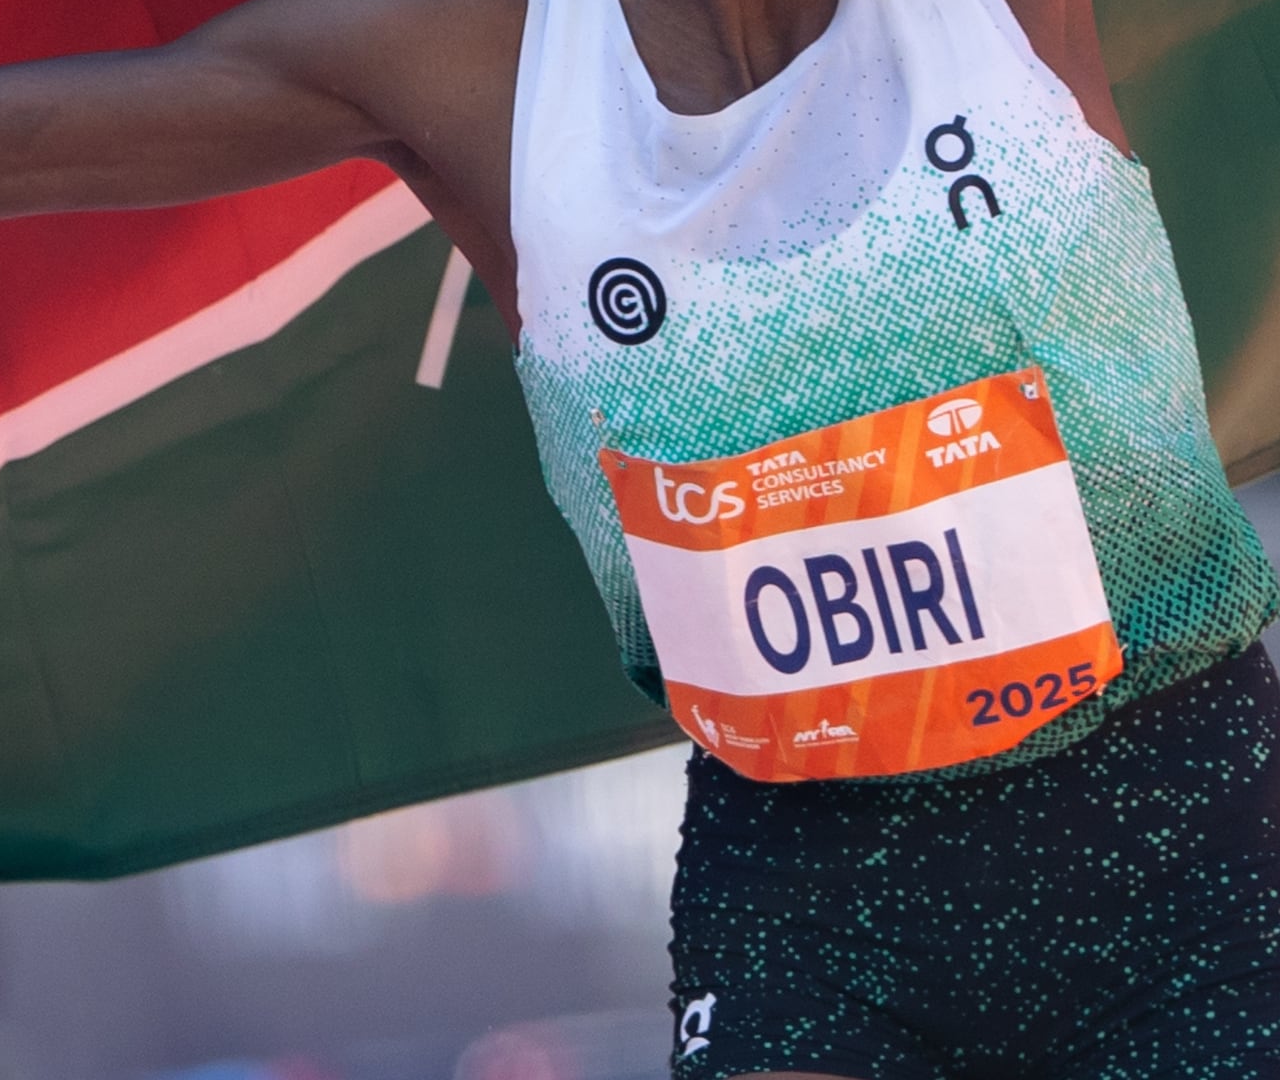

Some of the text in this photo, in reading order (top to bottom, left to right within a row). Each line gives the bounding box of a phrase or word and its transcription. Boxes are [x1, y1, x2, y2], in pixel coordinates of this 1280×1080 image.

[746, 450, 807, 476] TATA
[925, 431, 1001, 468] TATA
[752, 448, 887, 492] CONSULTANCY
[757, 480, 845, 509] SERVICES
[744, 528, 985, 674] OBIRI
[966, 662, 1096, 726] 2025
